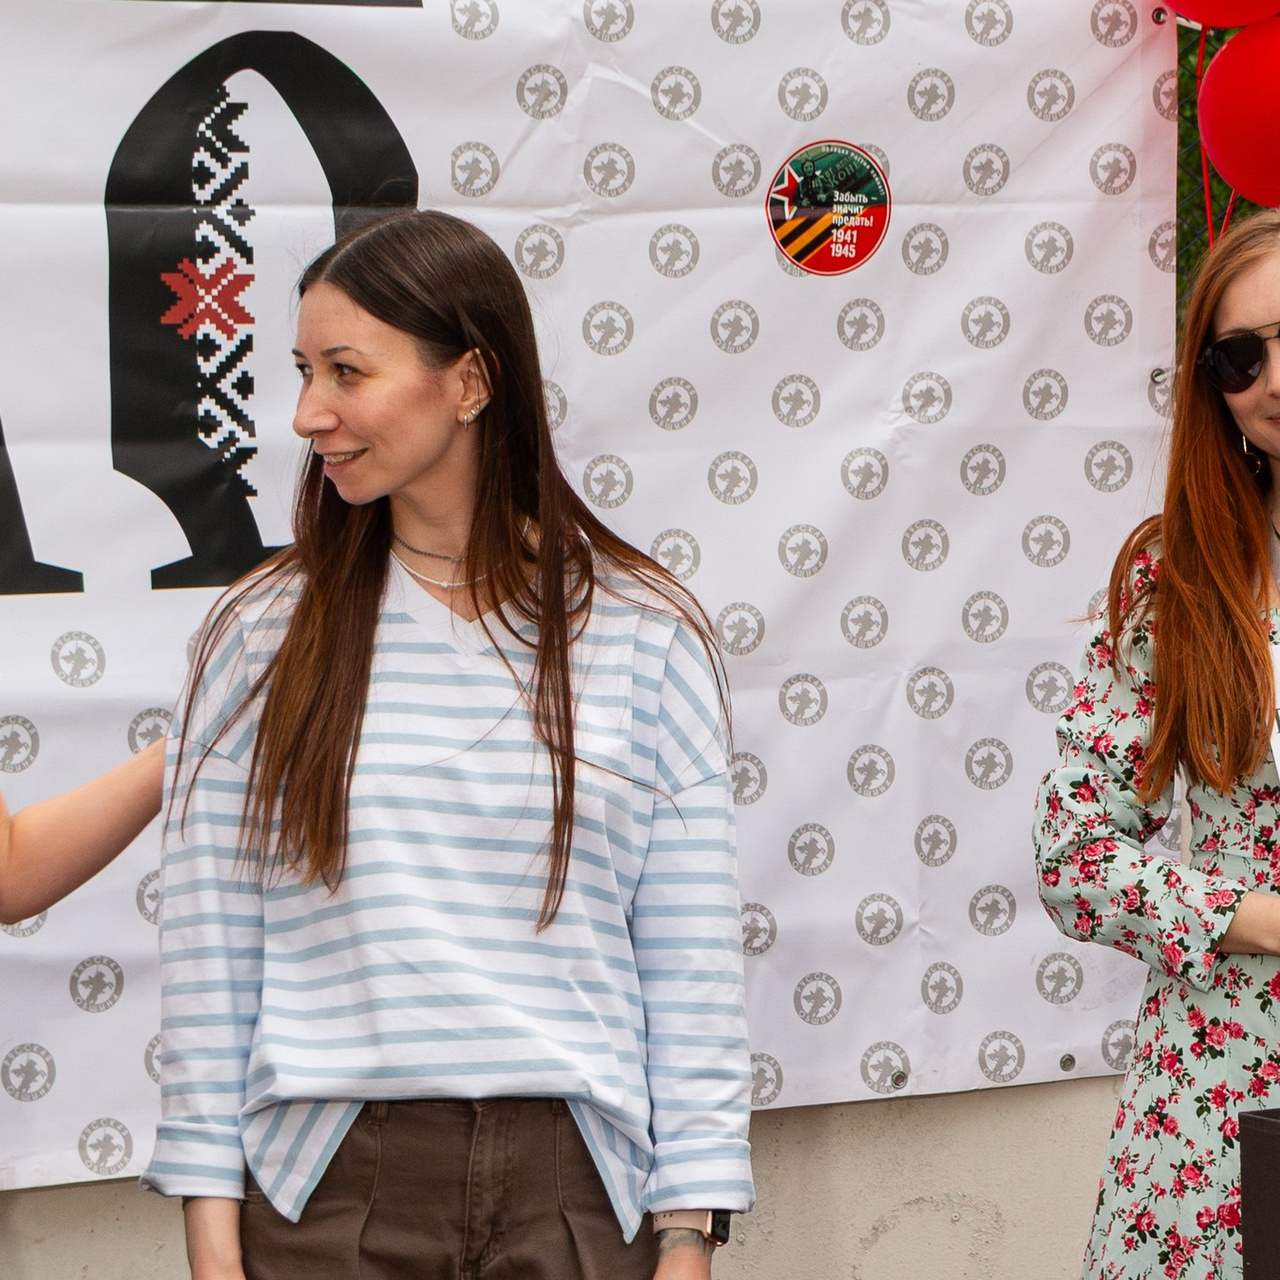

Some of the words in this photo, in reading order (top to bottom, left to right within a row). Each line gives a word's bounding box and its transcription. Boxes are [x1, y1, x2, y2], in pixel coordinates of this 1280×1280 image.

[833, 191, 869, 204] Забыть
[832, 204, 864, 215] значит
[832, 216, 874, 228] предать!
[831, 229, 858, 244] 1941
[830, 243, 856, 258] 1945
